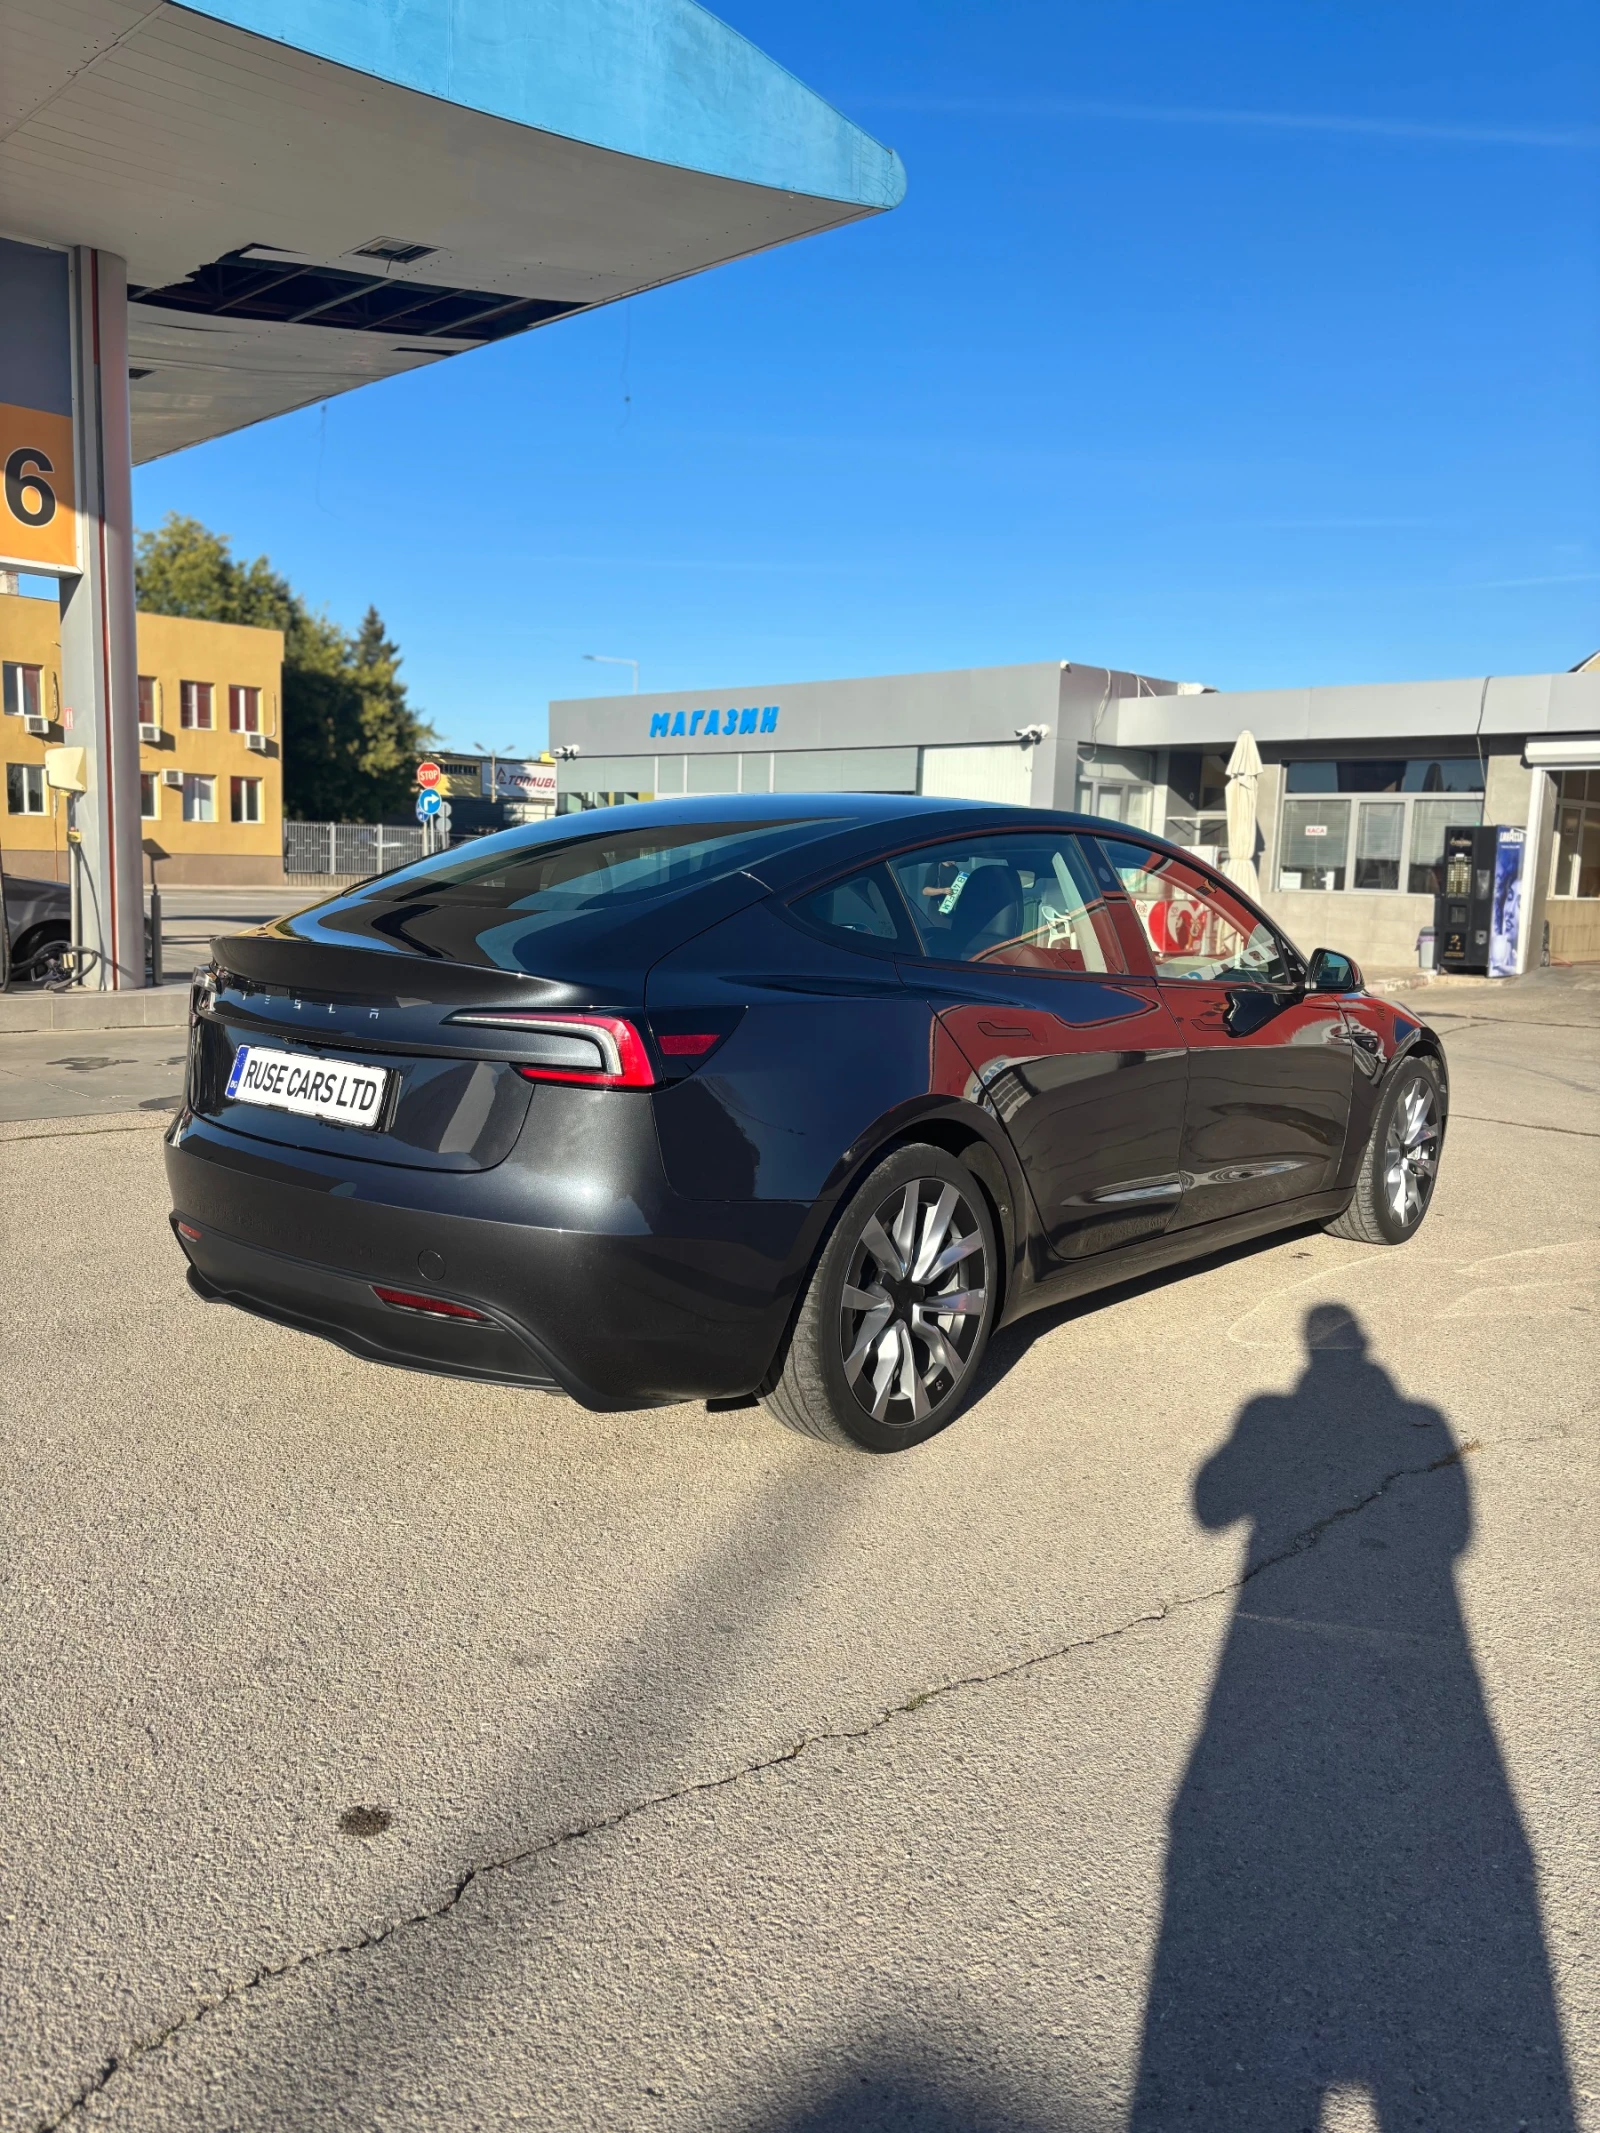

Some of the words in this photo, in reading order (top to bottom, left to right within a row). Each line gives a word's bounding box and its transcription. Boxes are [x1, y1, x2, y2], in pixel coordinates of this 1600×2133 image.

[4, 446, 57, 528] 6
[649, 706, 779, 738] МАГАЗИН
[420, 770, 438, 781] STOP
[241, 990, 379, 1019] TESLA
[229, 1080, 239, 1089] BG
[243, 1059, 289, 1094] RUSE
[286, 1067, 338, 1103] CARS
[336, 1075, 377, 1111] LTD
